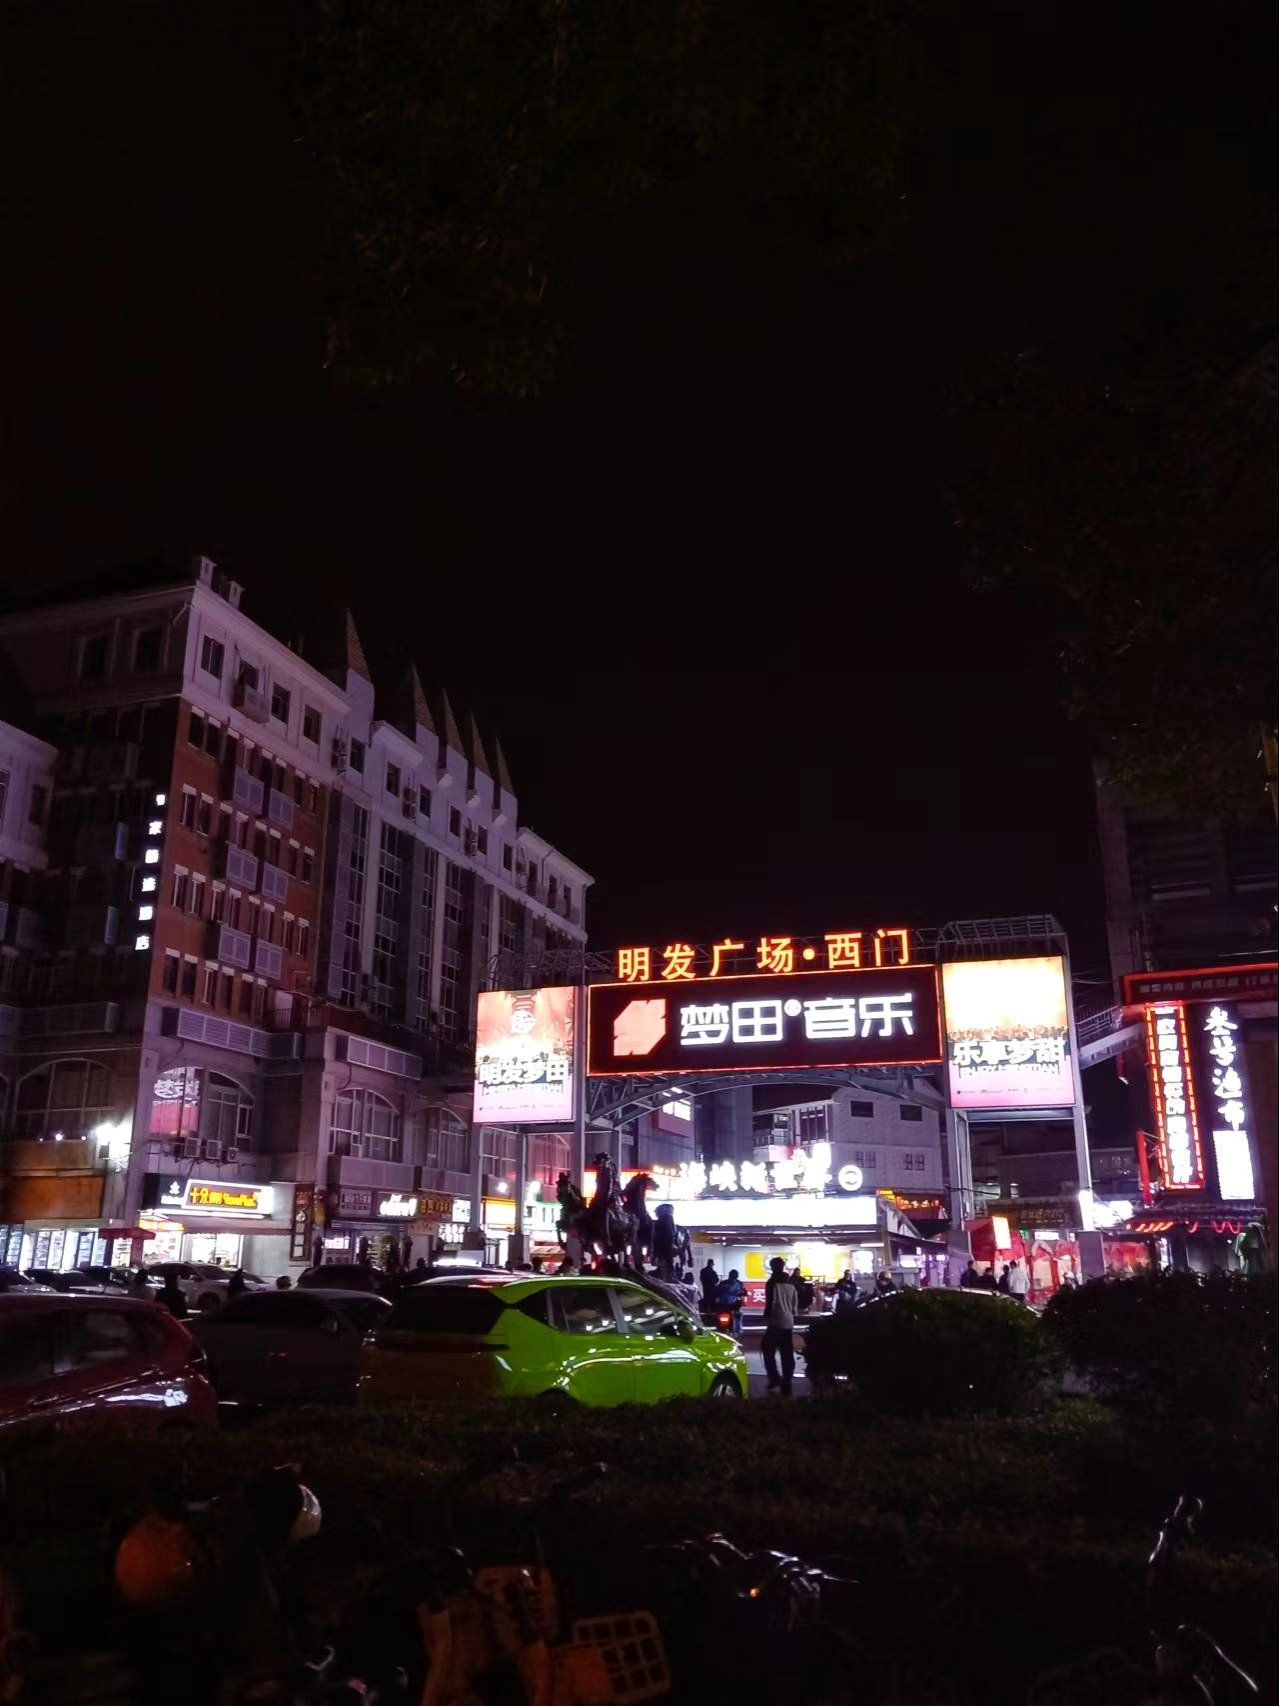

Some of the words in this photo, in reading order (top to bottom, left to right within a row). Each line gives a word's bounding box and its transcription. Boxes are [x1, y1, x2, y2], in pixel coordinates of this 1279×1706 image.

[617, 928, 909, 981] 明发广场·西门
